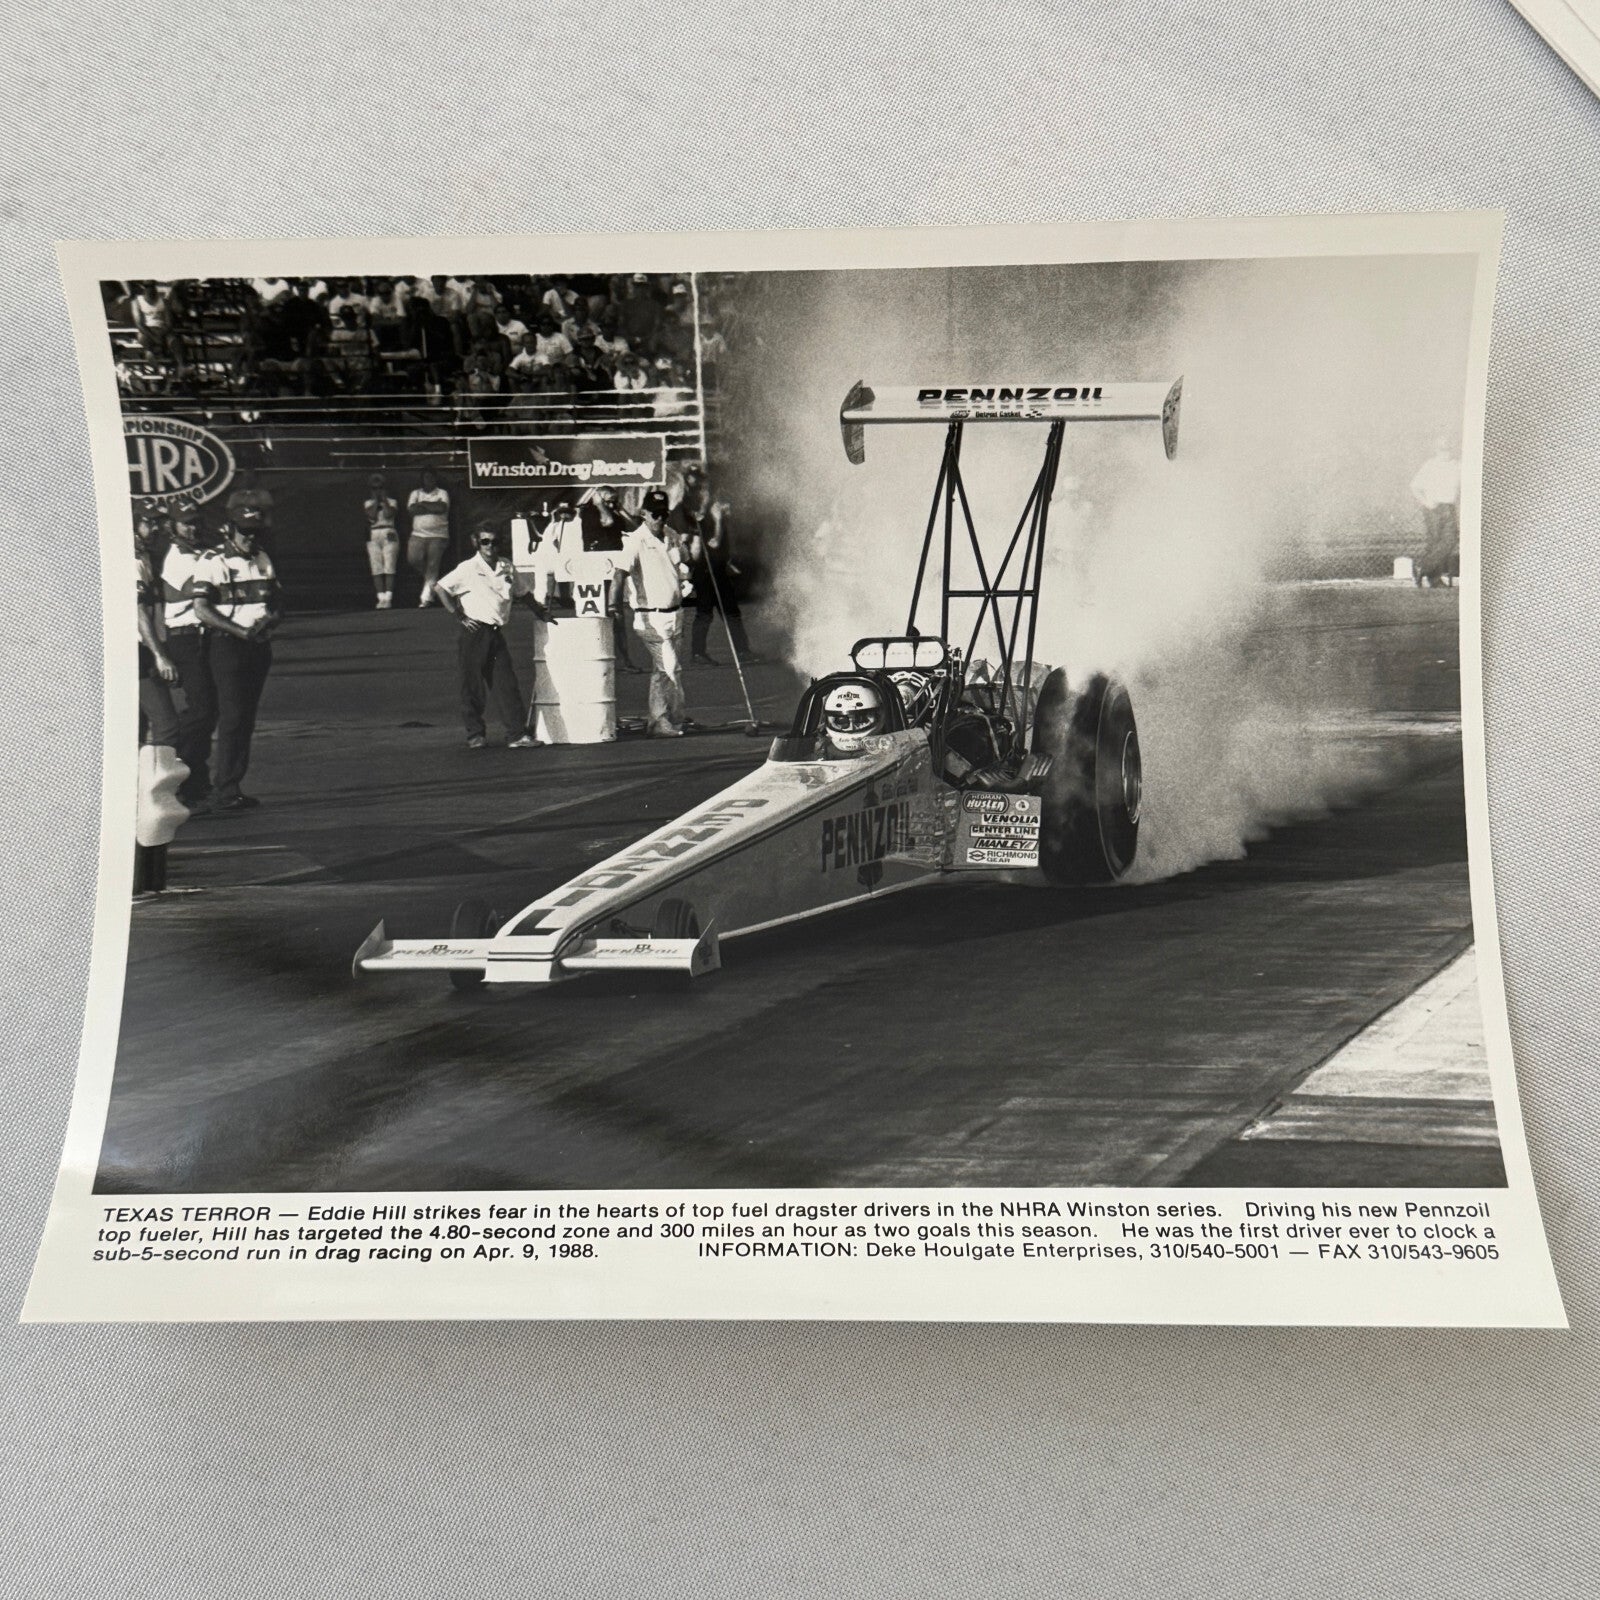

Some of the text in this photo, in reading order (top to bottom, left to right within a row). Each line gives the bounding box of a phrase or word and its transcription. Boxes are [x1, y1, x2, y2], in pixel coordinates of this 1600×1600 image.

[917, 387, 1104, 402] PENNZOIL
[124, 420, 204, 443] PIONSHIP
[474, 462, 547, 477] Winston
[549, 461, 592, 481] Drag
[983, 814, 1039, 824] VENOLIA
[972, 826, 1037, 835] CENTER LINE
[978, 840, 1026, 849] MANLEY
[987, 850, 1037, 859] RICHMOND
[103, 1207, 174, 1223] TEXAS
[181, 1206, 272, 1222] TERROR
[307, 1205, 366, 1221] Eddie
[372, 1205, 407, 1221] Hill
[412, 1204, 482, 1221] strikes
[488, 1203, 528, 1220] fear
[533, 1203, 551, 1219] in
[557, 1203, 591, 1219] the
[596, 1203, 659, 1219] hearts
[665, 1202, 686, 1218] of
[691, 1203, 725, 1221] top
[731, 1202, 768, 1218] fuel
[775, 1202, 858, 1221] dragster
[863, 1201, 931, 1218] drivers
[937, 1201, 955, 1217] in
[961, 1201, 994, 1218] the
[999, 1201, 1062, 1217] NHRA
[1066, 1201, 1150, 1218] Winston
[1156, 1201, 1222, 1218] series.
[1245, 1201, 1316, 1222] Driving
[1321, 1201, 1352, 1218] his
[1358, 1205, 1398, 1218] new
[1404, 1201, 1491, 1218] Pennzoil
[98, 1222, 1497, 1245] top fueler, Hill has targeted the 4.80-second zone and 300 miles an hour as two goals this season. He was the first driver ever to clock a
[92, 1245, 240, 1262] sub-5-second
[246, 1248, 281, 1261] run
[288, 1245, 308, 1260] in
[314, 1245, 361, 1264] drag
[368, 1244, 433, 1263] racing
[439, 1247, 466, 1260] on
[472, 1243, 515, 1263] Apr.
[522, 1243, 539, 1262] 9,
[548, 1243, 599, 1259] 1988.
[698, 1241, 858, 1258] INFORMATION:
[866, 1242, 916, 1258] Deke
[924, 1242, 1015, 1261] Houlgate
[1022, 1242, 1143, 1262] Enterprises,
[1149, 1242, 1279, 1259] 310/540-5001
[1318, 1243, 1362, 1260] FAX
[1367, 1243, 1500, 1260] 310/543-9605
